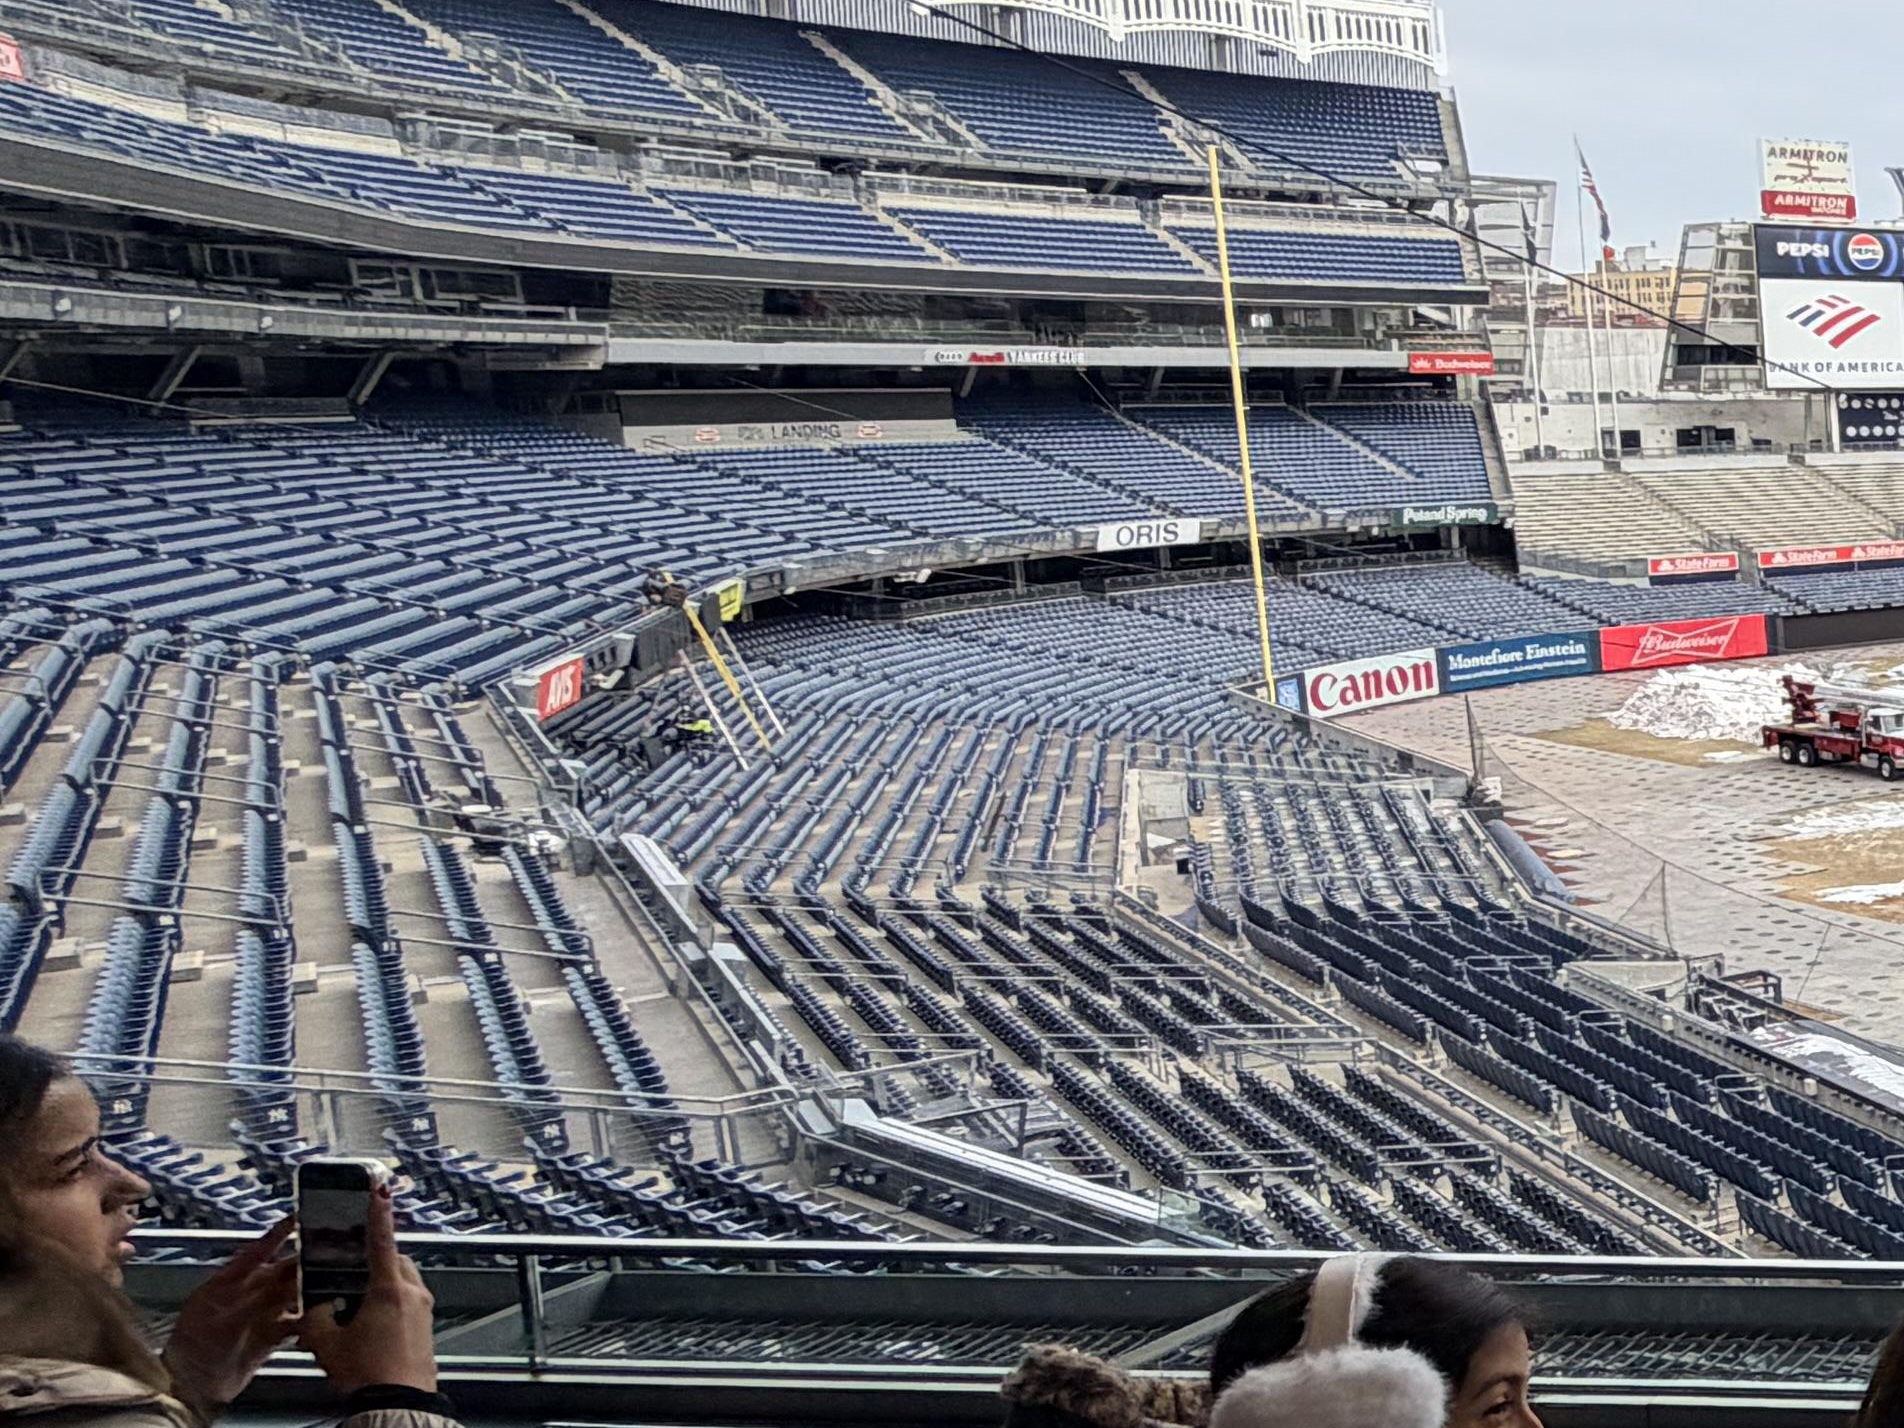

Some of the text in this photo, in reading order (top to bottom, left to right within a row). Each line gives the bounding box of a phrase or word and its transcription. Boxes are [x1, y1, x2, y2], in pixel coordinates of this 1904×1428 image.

[1767, 147, 1848, 164] ARMITRON
[1774, 194, 1848, 209] ARMITRON
[1776, 241, 1830, 258] PEPSI
[1435, 358, 1492, 370] Budweiser
[1814, 362, 1833, 373] OF
[1836, 361, 1904, 373] AMERICA
[771, 424, 842, 439] LANDING
[1403, 506, 1488, 524] Poland Spring
[1116, 522, 1179, 547] ORIS
[1640, 632, 1732, 655] Budweiser
[1449, 647, 1524, 671] Montefiore
[1525, 639, 1586, 660] Einstein
[1309, 660, 1435, 713] Canon
